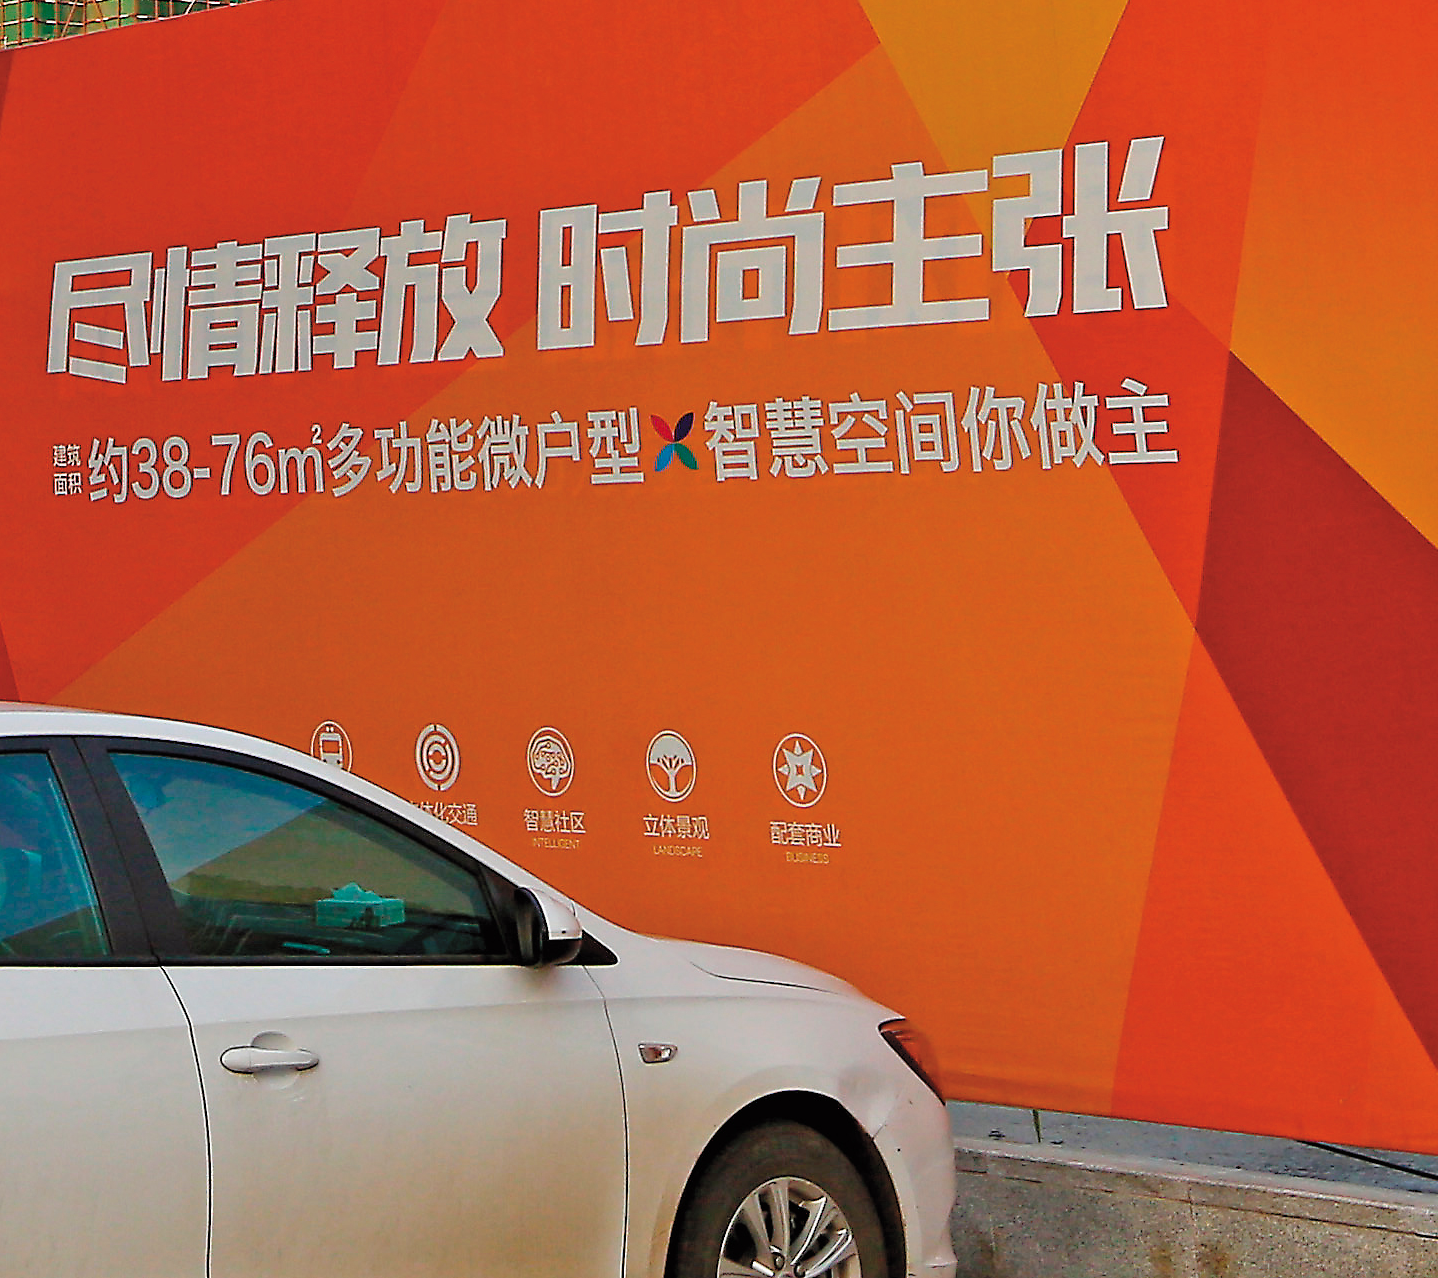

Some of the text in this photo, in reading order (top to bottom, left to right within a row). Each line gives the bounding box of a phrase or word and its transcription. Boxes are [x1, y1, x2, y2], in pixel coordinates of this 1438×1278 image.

[46, 134, 1170, 384] 尽情释放 时尚主张
[702, 377, 1180, 483] 智慧空间你做主
[52, 444, 82, 467] 建筑
[53, 471, 83, 495] 面积
[410, 800, 478, 826] 体化交通
[523, 808, 587, 834] 智慧社区
[642, 813, 710, 840] 立体景观
[769, 820, 842, 848] 配套商业
